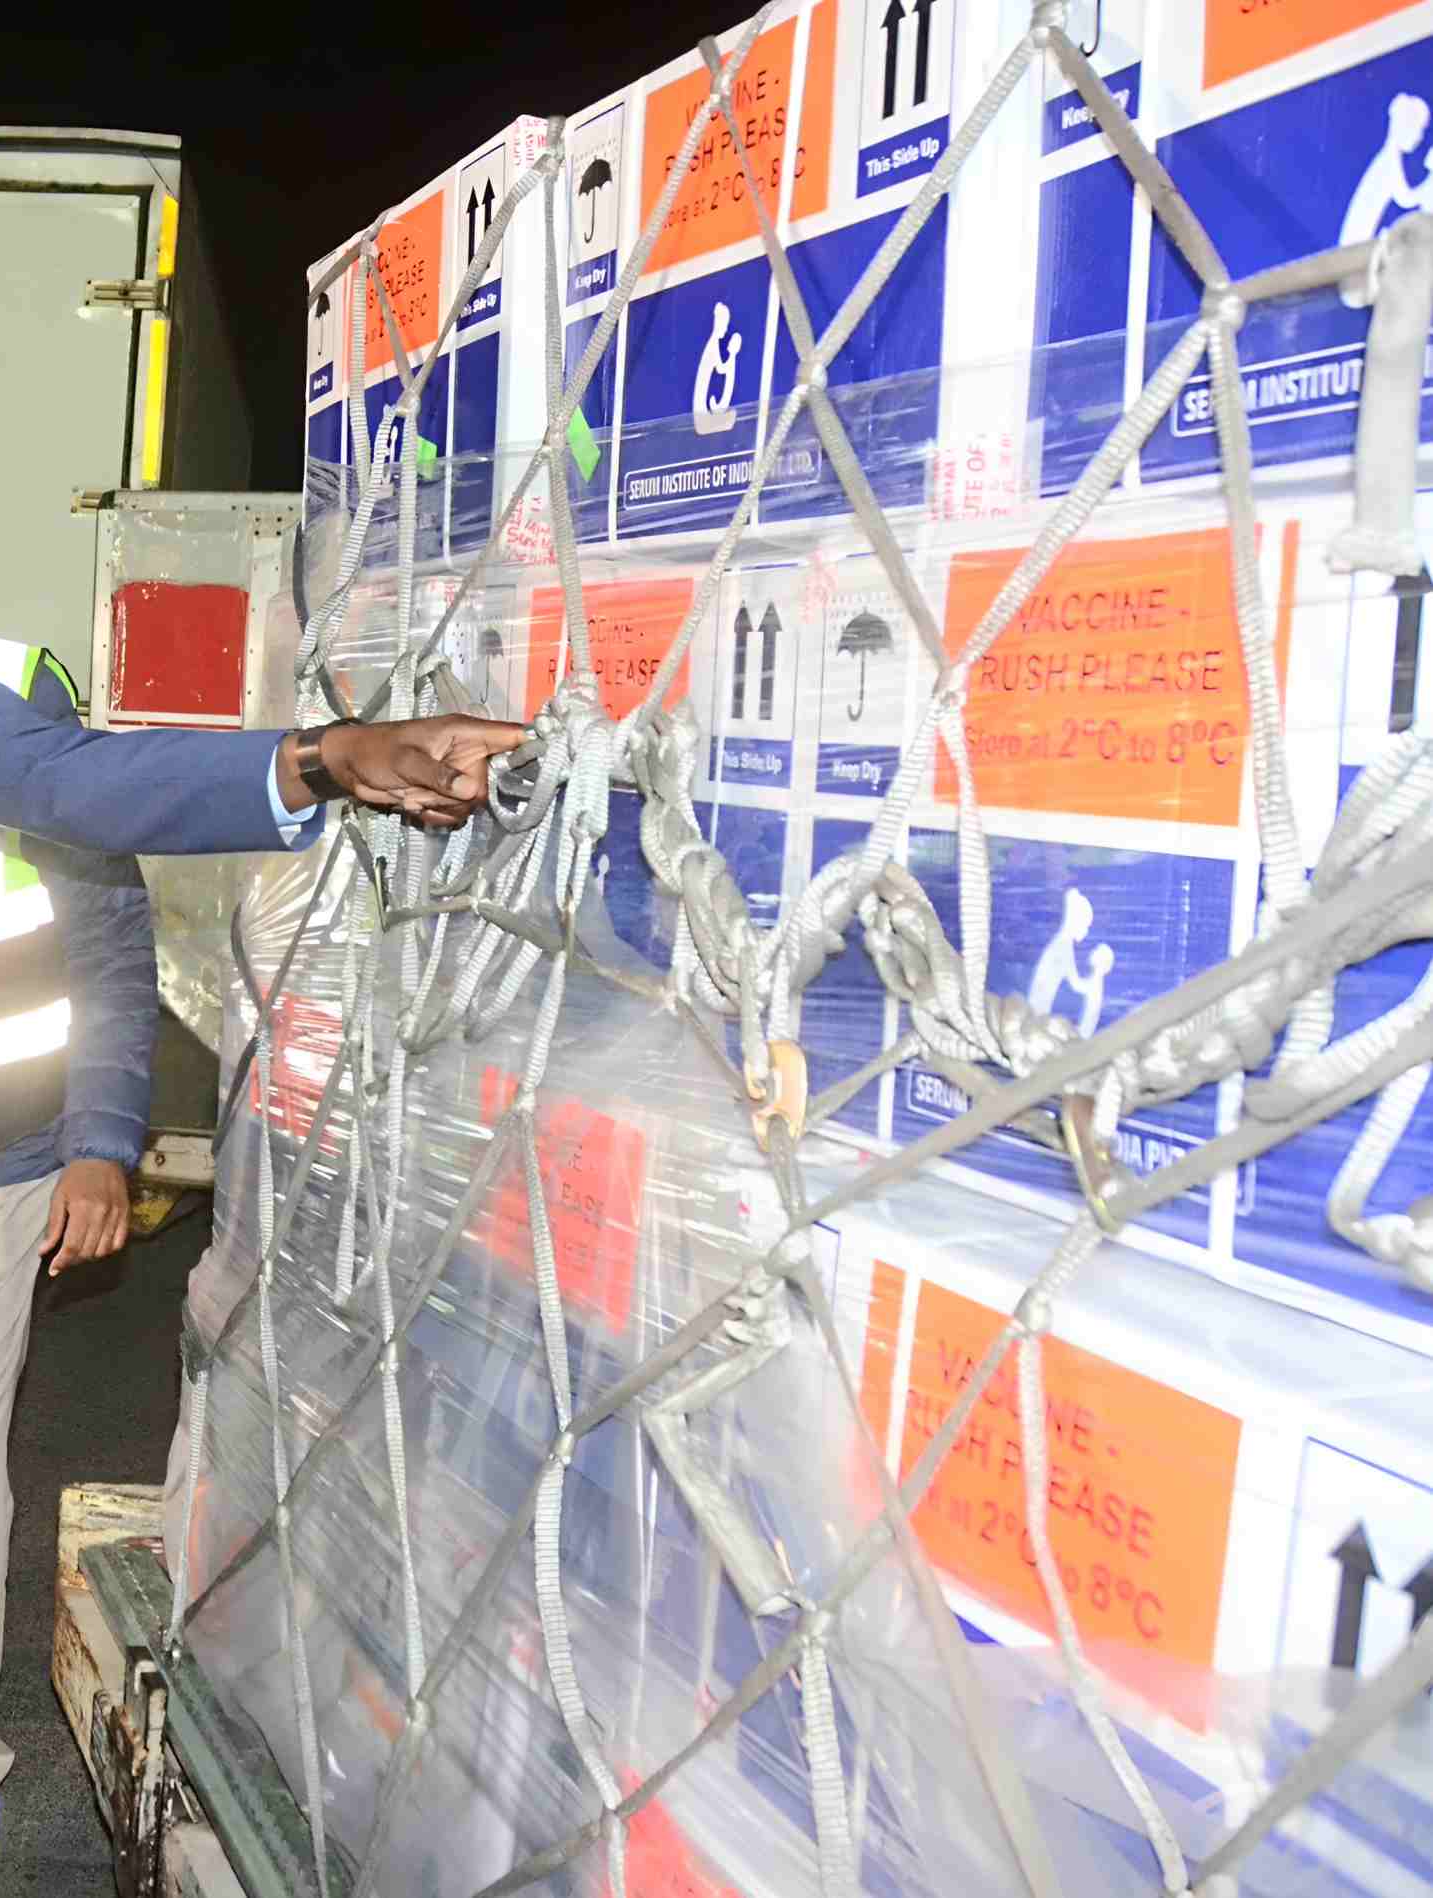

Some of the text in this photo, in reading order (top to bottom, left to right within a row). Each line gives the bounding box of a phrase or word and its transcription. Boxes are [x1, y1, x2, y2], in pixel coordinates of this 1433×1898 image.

[865, 137, 940, 179] This Side Up
[1259, 358, 1364, 407] INSTITUT
[629, 477, 660, 501] SERUM
[661, 466, 711, 496] INSTITUTE
[712, 464, 727, 488] OF
[728, 460, 754, 484] INDI
[981, 650, 1224, 693] RUSH PLEASE
[740, 751, 765, 770] Side
[766, 752, 783, 776] Up
[1058, 718, 1122, 761] 2°C
[1128, 730, 1157, 764] to
[1168, 719, 1239, 766] 8°C
[861, 760, 883, 786] Dry
[999, 1439, 1155, 1561] PEASE
[1090, 1562, 1166, 1640] 8°C
